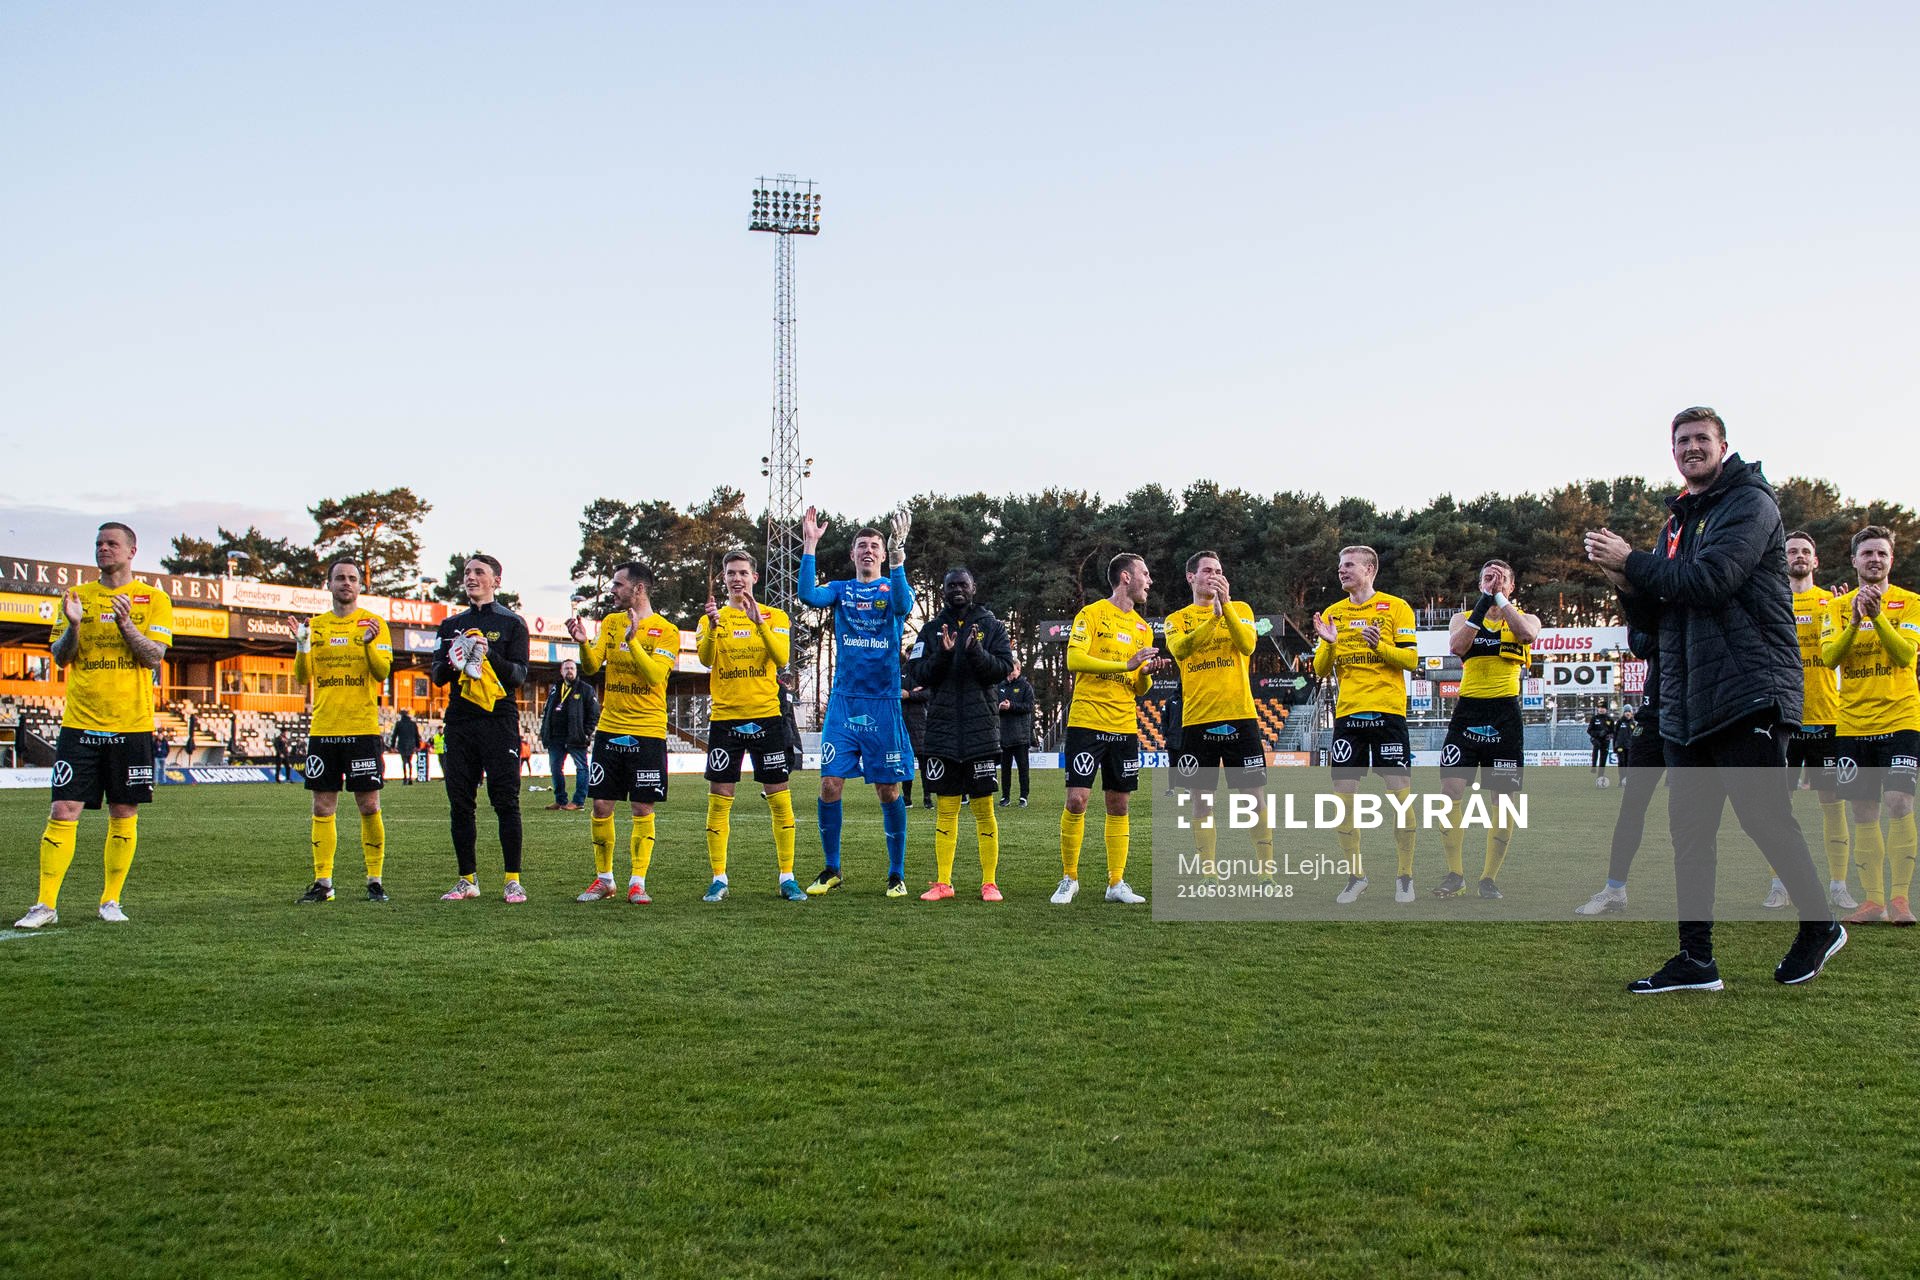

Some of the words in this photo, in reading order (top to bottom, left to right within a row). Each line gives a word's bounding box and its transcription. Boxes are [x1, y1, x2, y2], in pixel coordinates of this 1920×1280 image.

[392, 601, 433, 622] SAVE
[247, 618, 293, 639] Sölvesbor
[843, 634, 869, 648] Sweden
[870, 637, 889, 649] Rock
[1338, 653, 1365, 665] Sweden
[1813, 655, 1823, 667] Ro
[1188, 660, 1216, 673] Sweden
[1217, 657, 1235, 668] Rock
[1624, 662, 1644, 672] SYD
[1875, 663, 1892, 676] Roc
[719, 667, 748, 679] Sweden
[749, 665, 767, 678] Rock
[317, 675, 344, 688] Sweden
[345, 674, 365, 687] Rock
[607, 681, 630, 694] weden
[631, 683, 651, 695] Rock
[1412, 698, 1431, 707] BLT
[1524, 697, 1543, 706] BLT
[1381, 745, 1404, 753] LB-HUS
[763, 752, 786, 762] LB-HUS
[1891, 758, 1918, 767] LB-HUS
[351, 760, 376, 769] LB-HUS
[418, 752, 427, 781] SELECT
[974, 761, 996, 771] LB-HUS
[1494, 761, 1517, 769] LB-HUS
[1824, 759, 1836, 767] LB-
[128, 768, 152, 776] LB-HU
[189, 768, 269, 783] ALLSVENSKAN
[637, 772, 661, 780] LB-HUS
